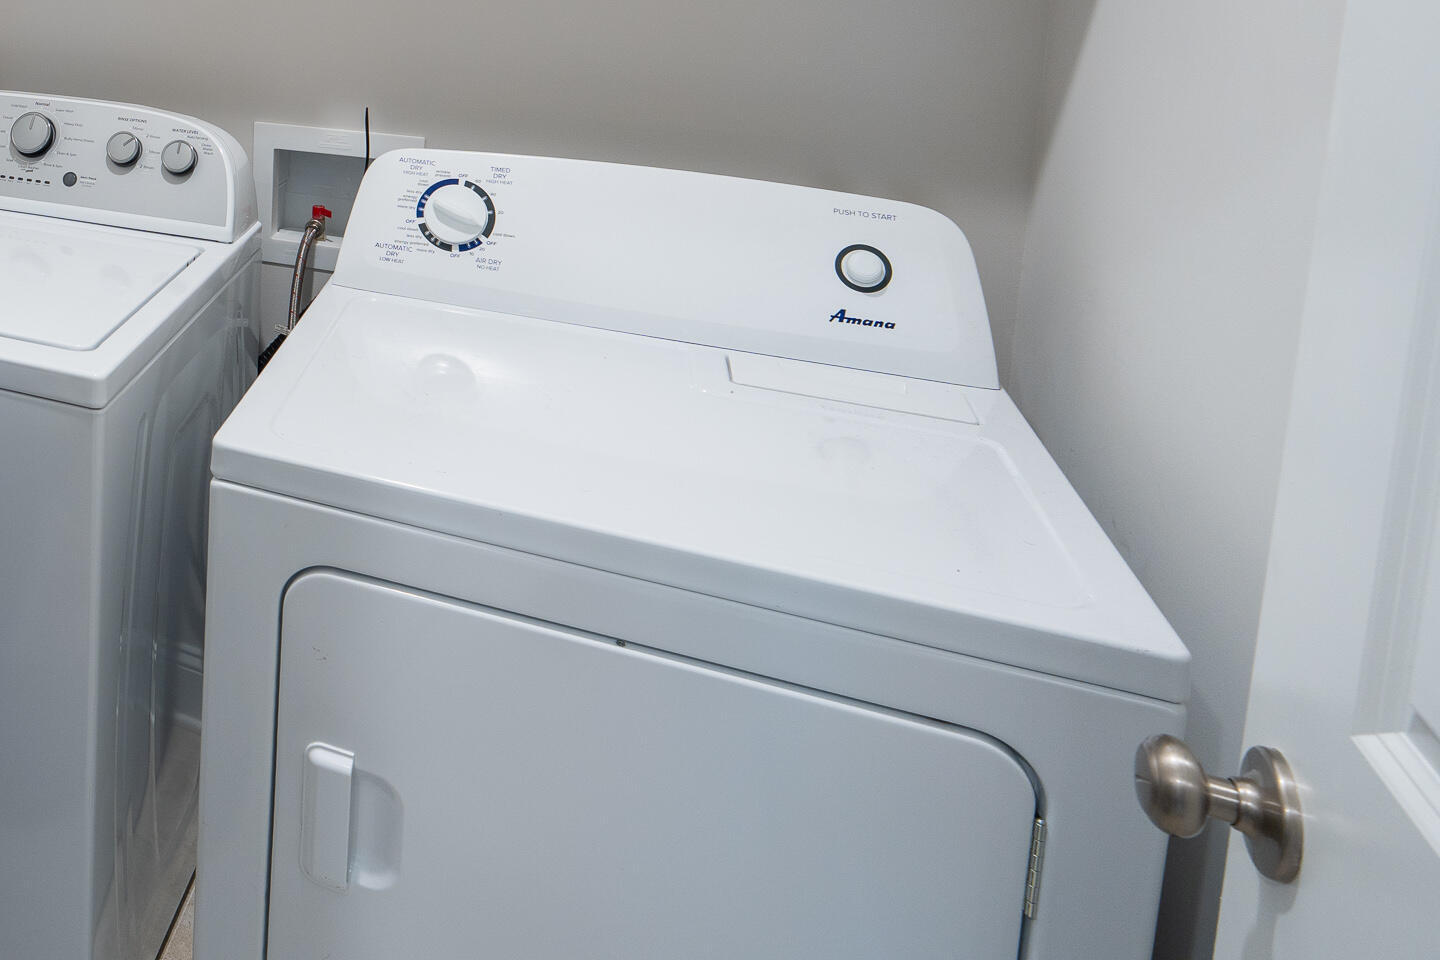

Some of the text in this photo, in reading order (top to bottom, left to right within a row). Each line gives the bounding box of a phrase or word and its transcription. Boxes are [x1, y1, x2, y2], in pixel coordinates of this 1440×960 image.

[399, 156, 437, 166] AUTOMATIC
[833, 208, 897, 222] PUSH TO START
[374, 242, 413, 252] AUTOMATIC
[829, 308, 896, 330] Amana
